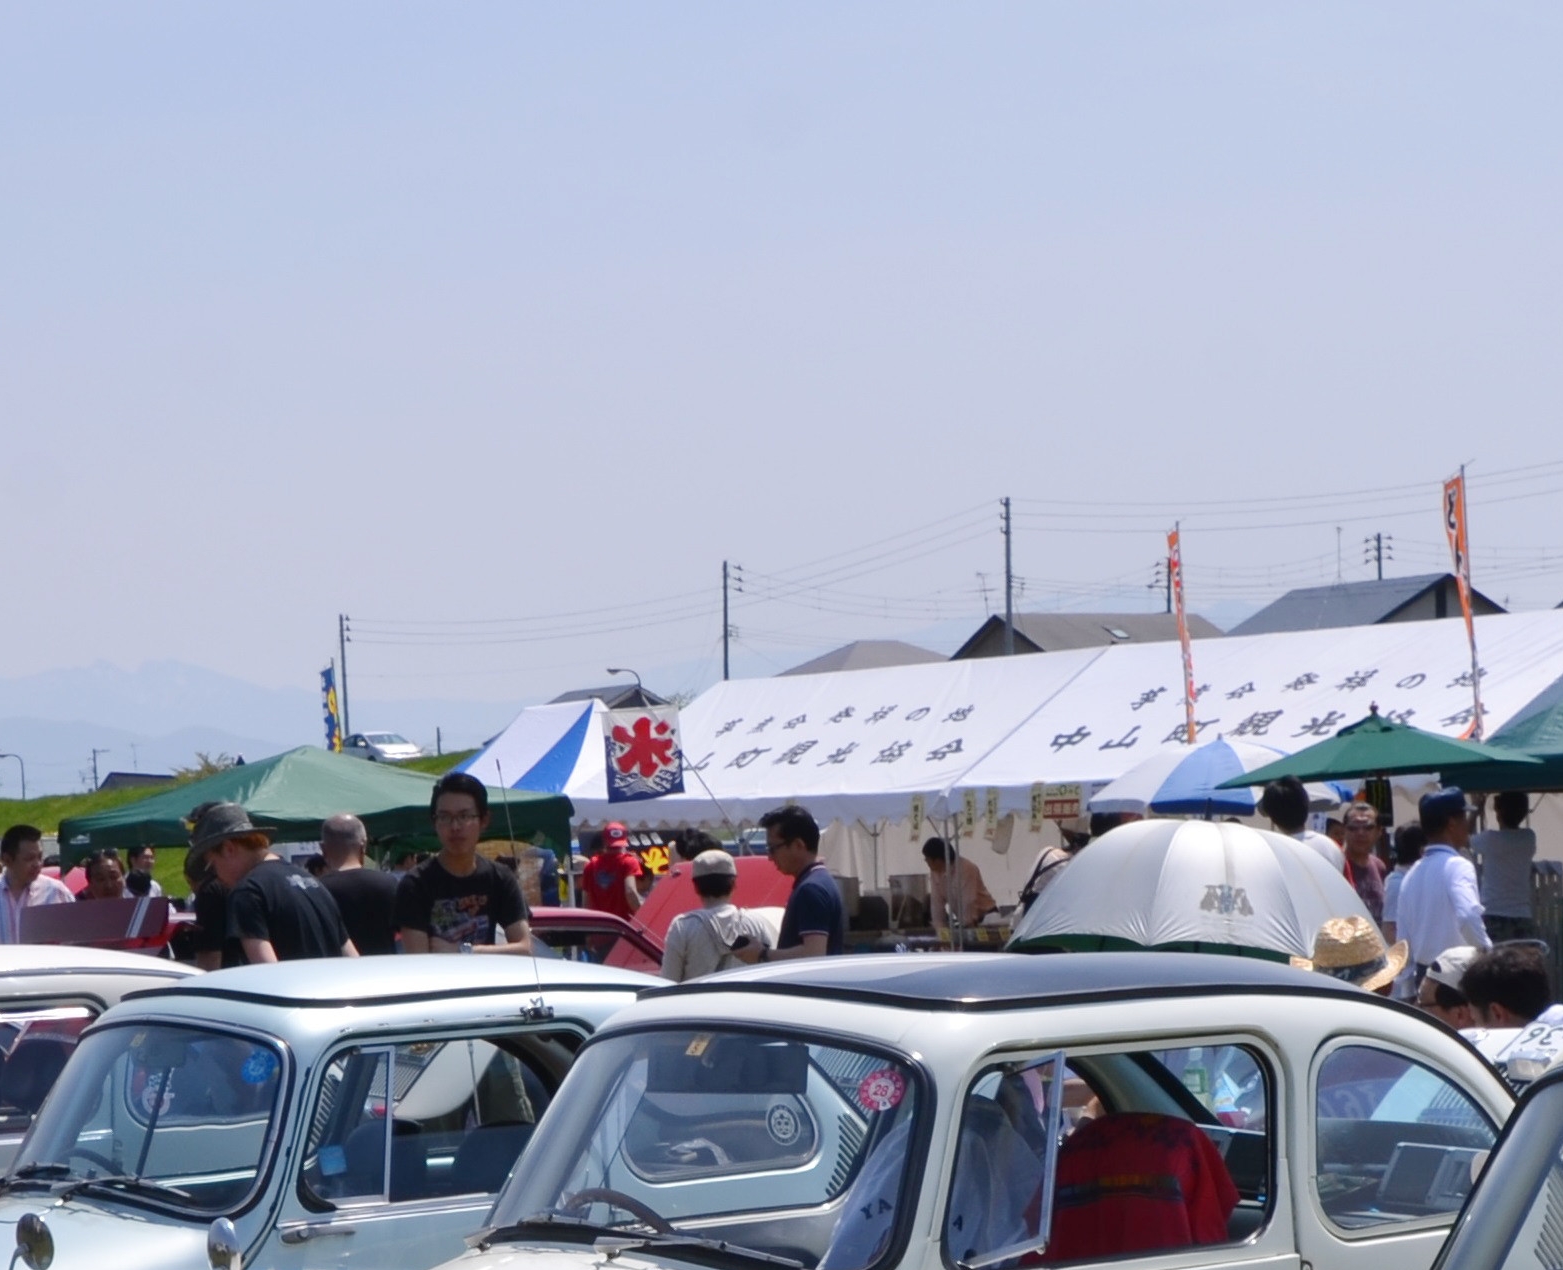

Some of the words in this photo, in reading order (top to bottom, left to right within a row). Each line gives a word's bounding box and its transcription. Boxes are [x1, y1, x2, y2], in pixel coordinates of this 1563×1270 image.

[612, 716, 674, 778] 氷
[682, 738, 964, 771] 山町観光協会
